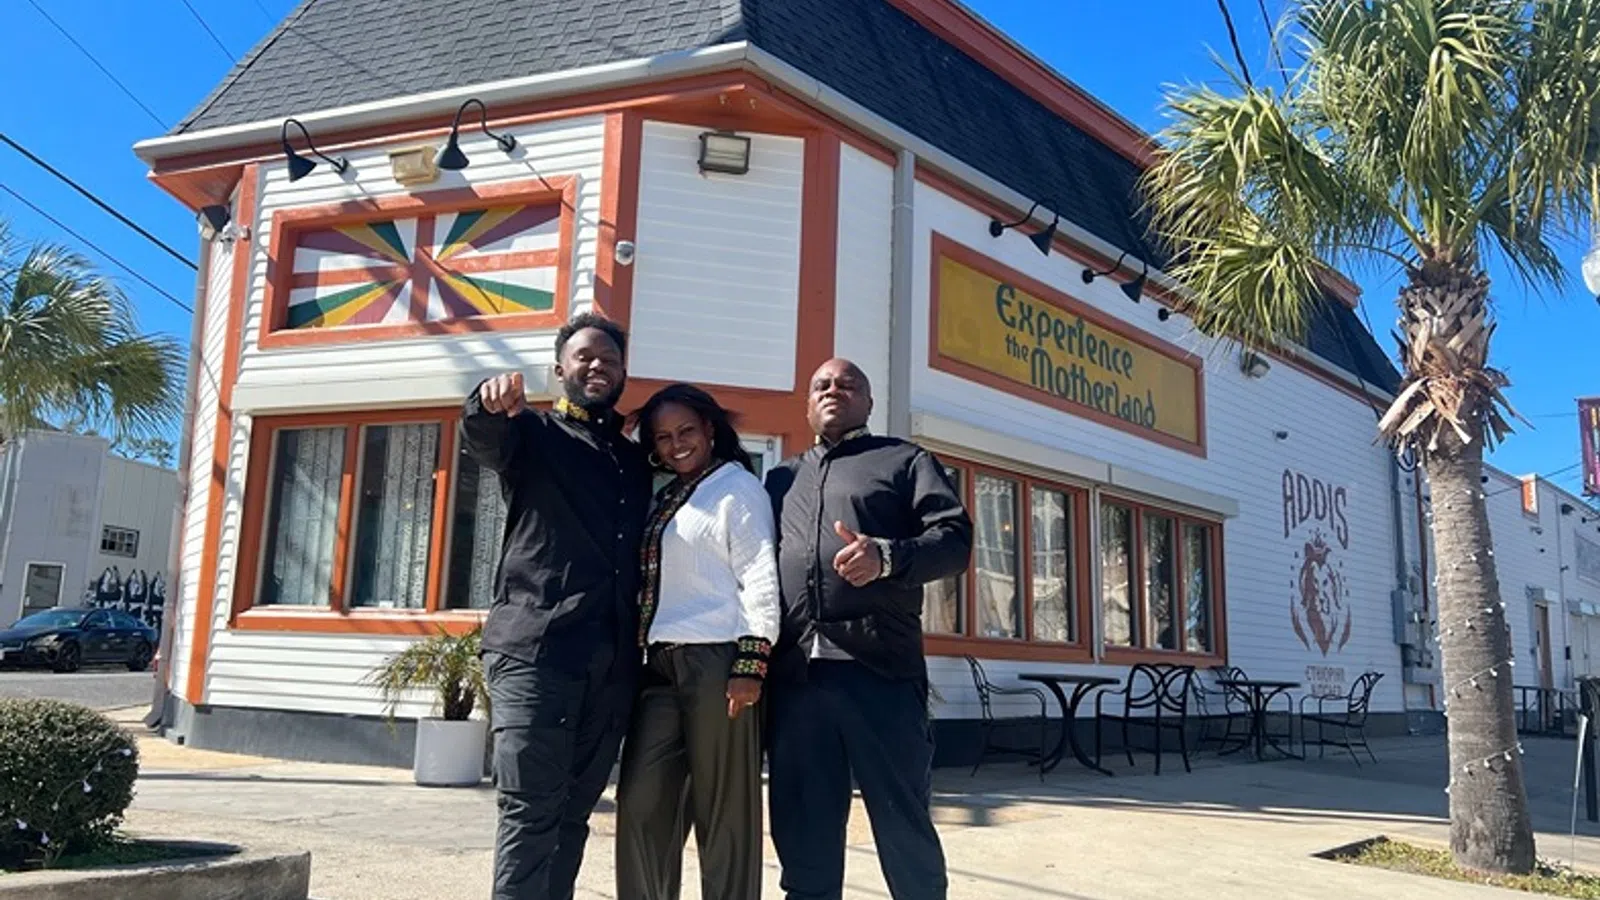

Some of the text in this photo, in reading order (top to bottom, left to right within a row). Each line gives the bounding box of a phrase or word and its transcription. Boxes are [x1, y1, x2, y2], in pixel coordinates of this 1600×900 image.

[996, 284, 1133, 380] Experience
[1005, 334, 1028, 362] the
[1282, 468, 1349, 550] ADDIS
